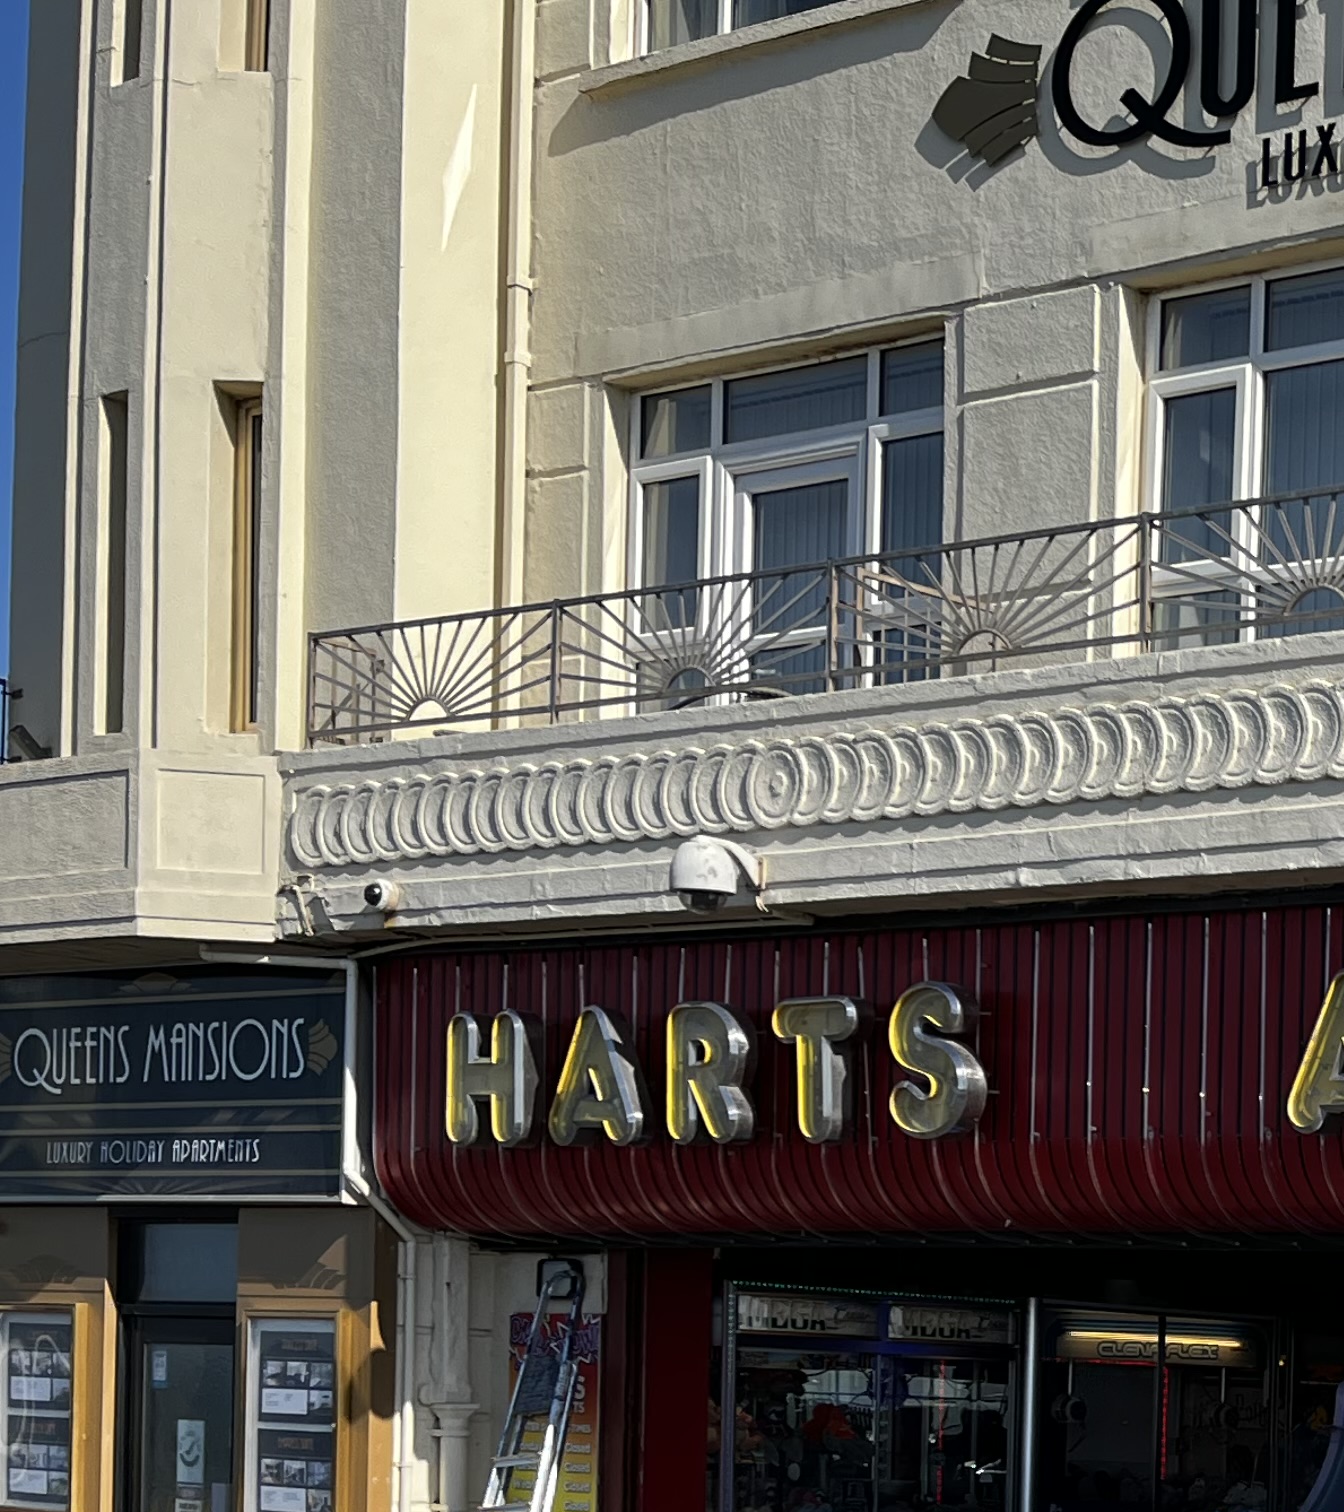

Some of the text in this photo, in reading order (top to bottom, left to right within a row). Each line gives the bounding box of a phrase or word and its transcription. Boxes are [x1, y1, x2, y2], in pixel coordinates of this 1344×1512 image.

[14, 1018, 305, 1094] QUEENS MANSIONS
[445, 980, 988, 1147] HARTS
[46, 1138, 260, 1164] LUXURY HOLIDAY APARTMENTS
